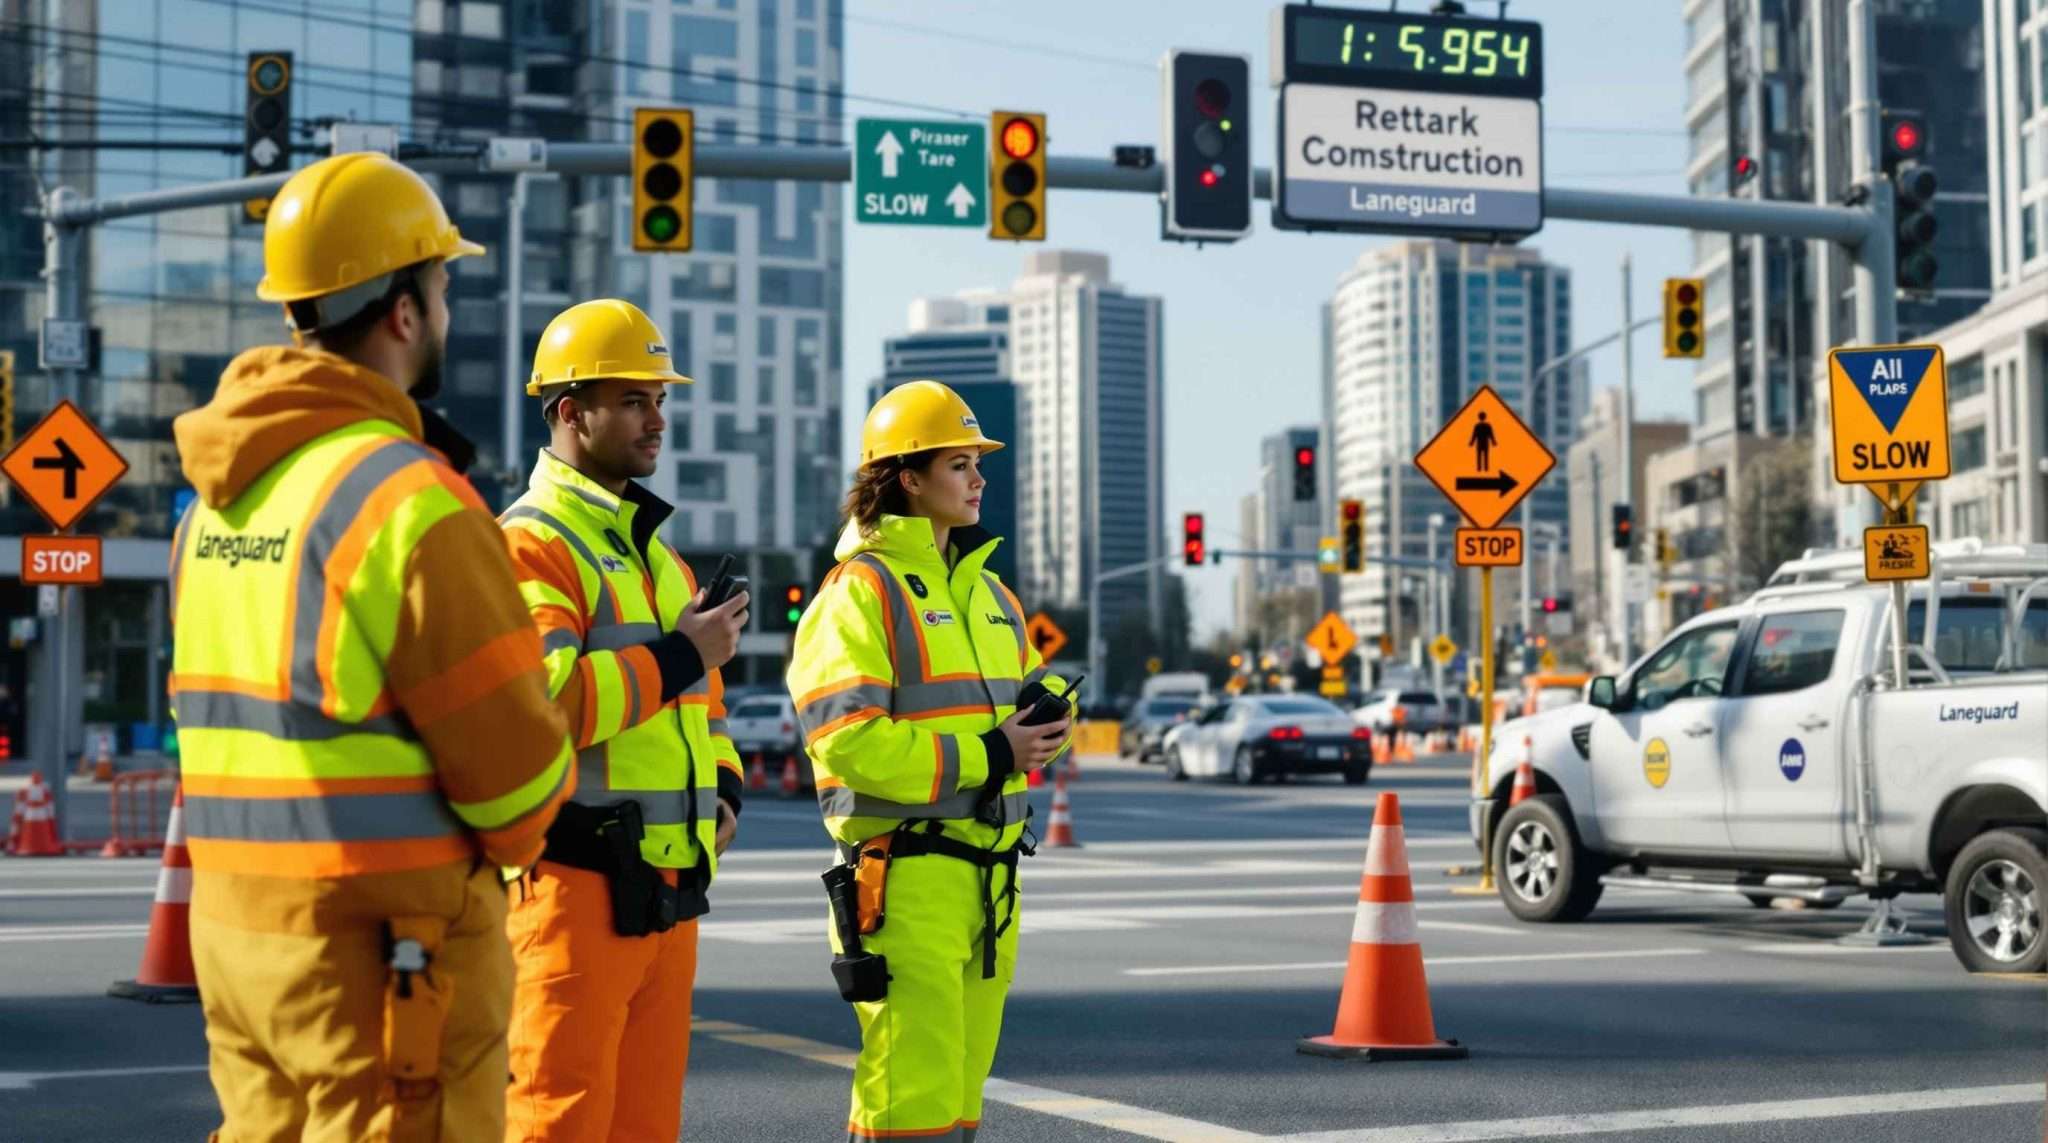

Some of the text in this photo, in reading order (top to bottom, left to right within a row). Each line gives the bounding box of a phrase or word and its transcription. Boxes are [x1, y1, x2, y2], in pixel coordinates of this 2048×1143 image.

[1356, 99, 1480, 137] Rettark
[918, 148, 956, 168] Tare
[1301, 135, 1524, 178] Comstruction
[864, 192, 929, 217] SLOW
[1350, 186, 1477, 217] Laneguard
[1852, 440, 1931, 471] SLOW
[1464, 536, 1516, 557] STOP
[32, 550, 92, 574] STOP
[1939, 700, 2019, 724] Laneguard
